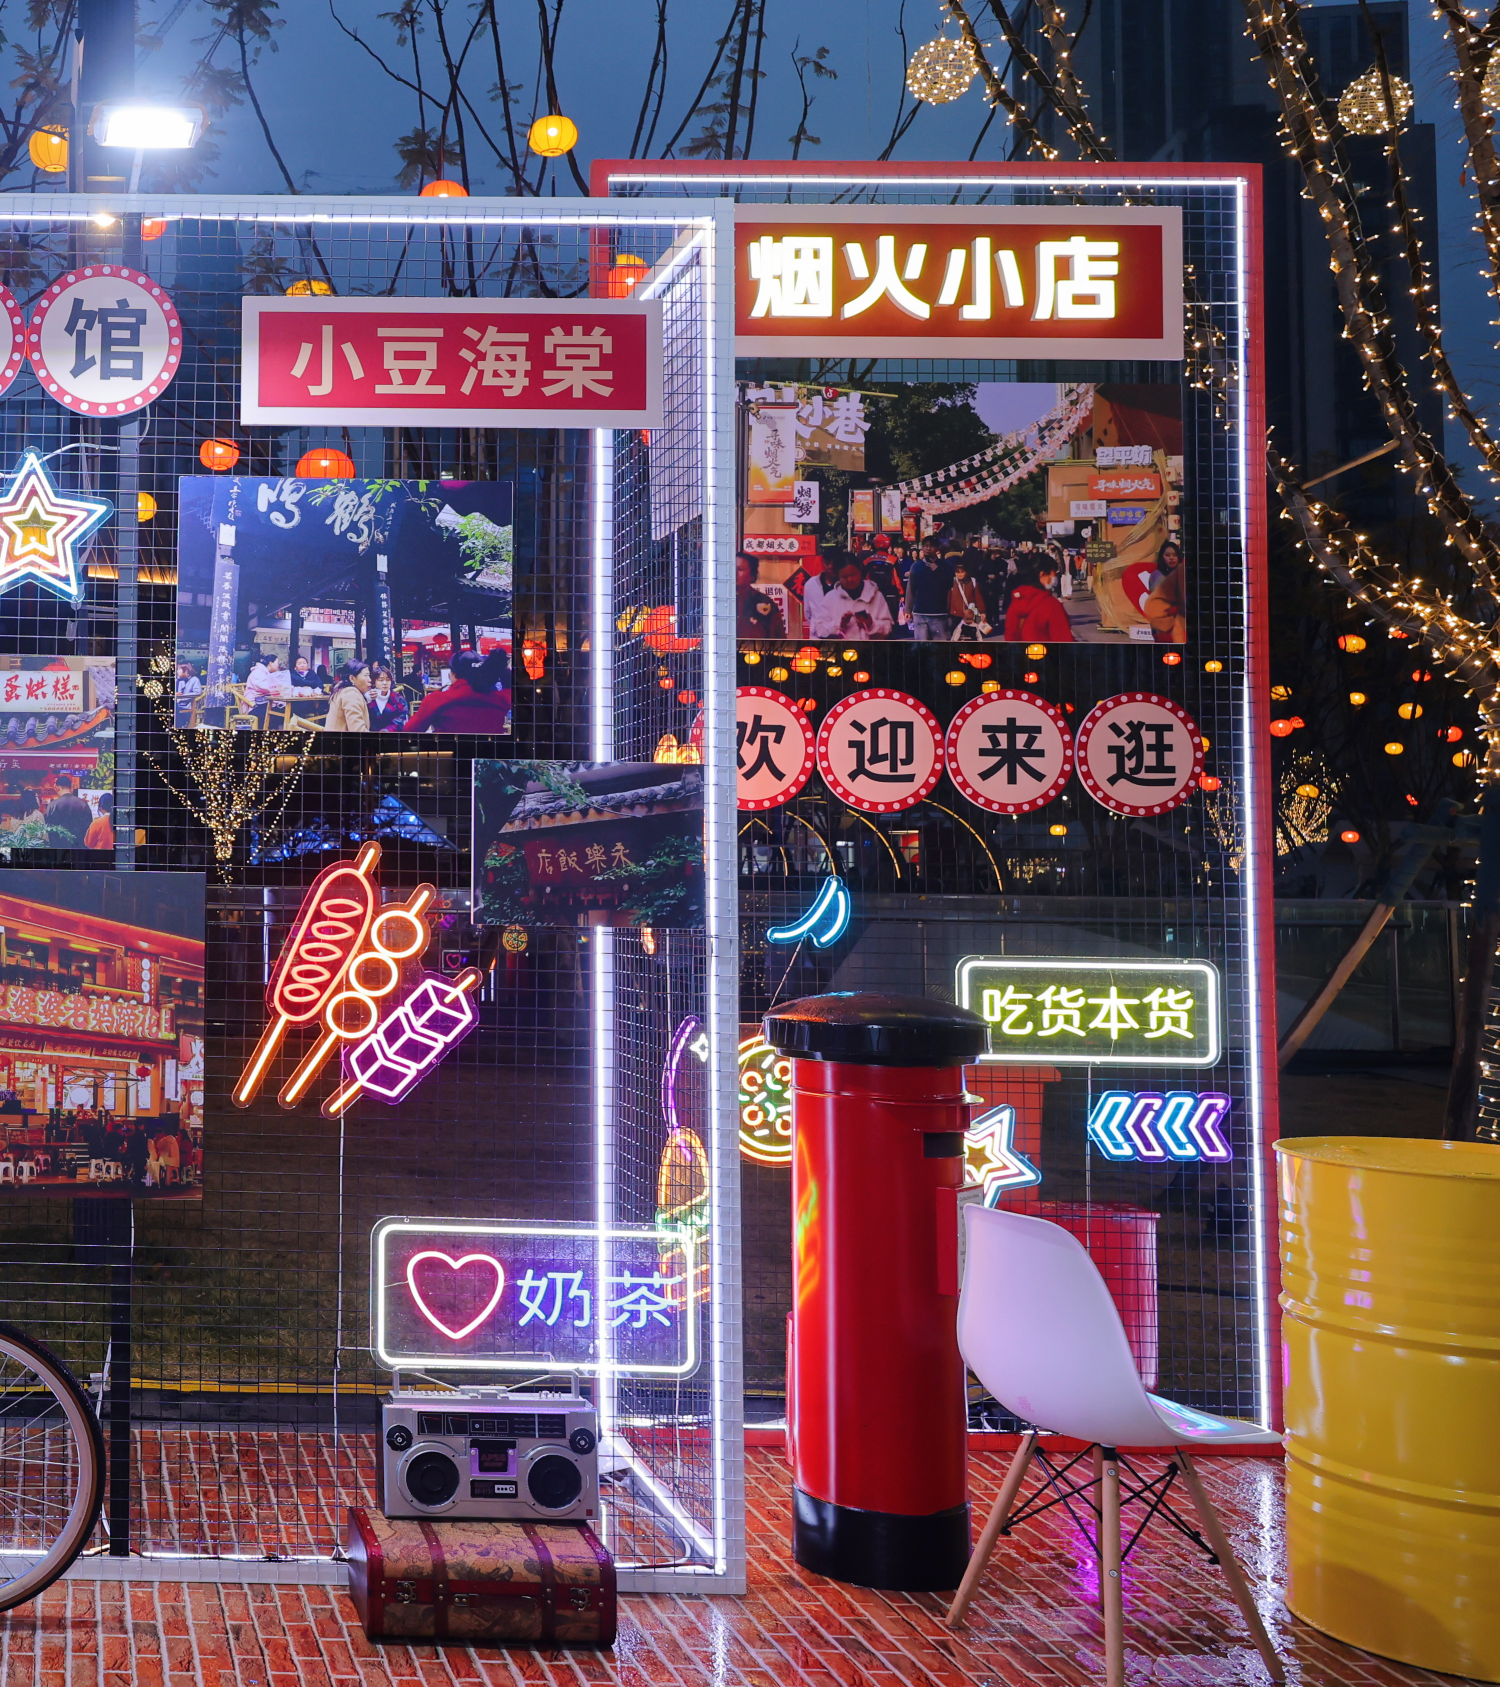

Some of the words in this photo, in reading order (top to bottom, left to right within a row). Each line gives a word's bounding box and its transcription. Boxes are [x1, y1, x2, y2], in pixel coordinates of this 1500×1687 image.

[748, 233, 1121, 322] 烟火小店
[288, 323, 615, 400] 小豆海棠
[1093, 478, 1155, 494] 寻味烟火气
[1096, 445, 1153, 467] 望平坊
[736, 714, 1178, 787] 欢迎来逛
[982, 984, 1195, 1041] 吃货本货
[516, 1268, 683, 1329] 奶茶
